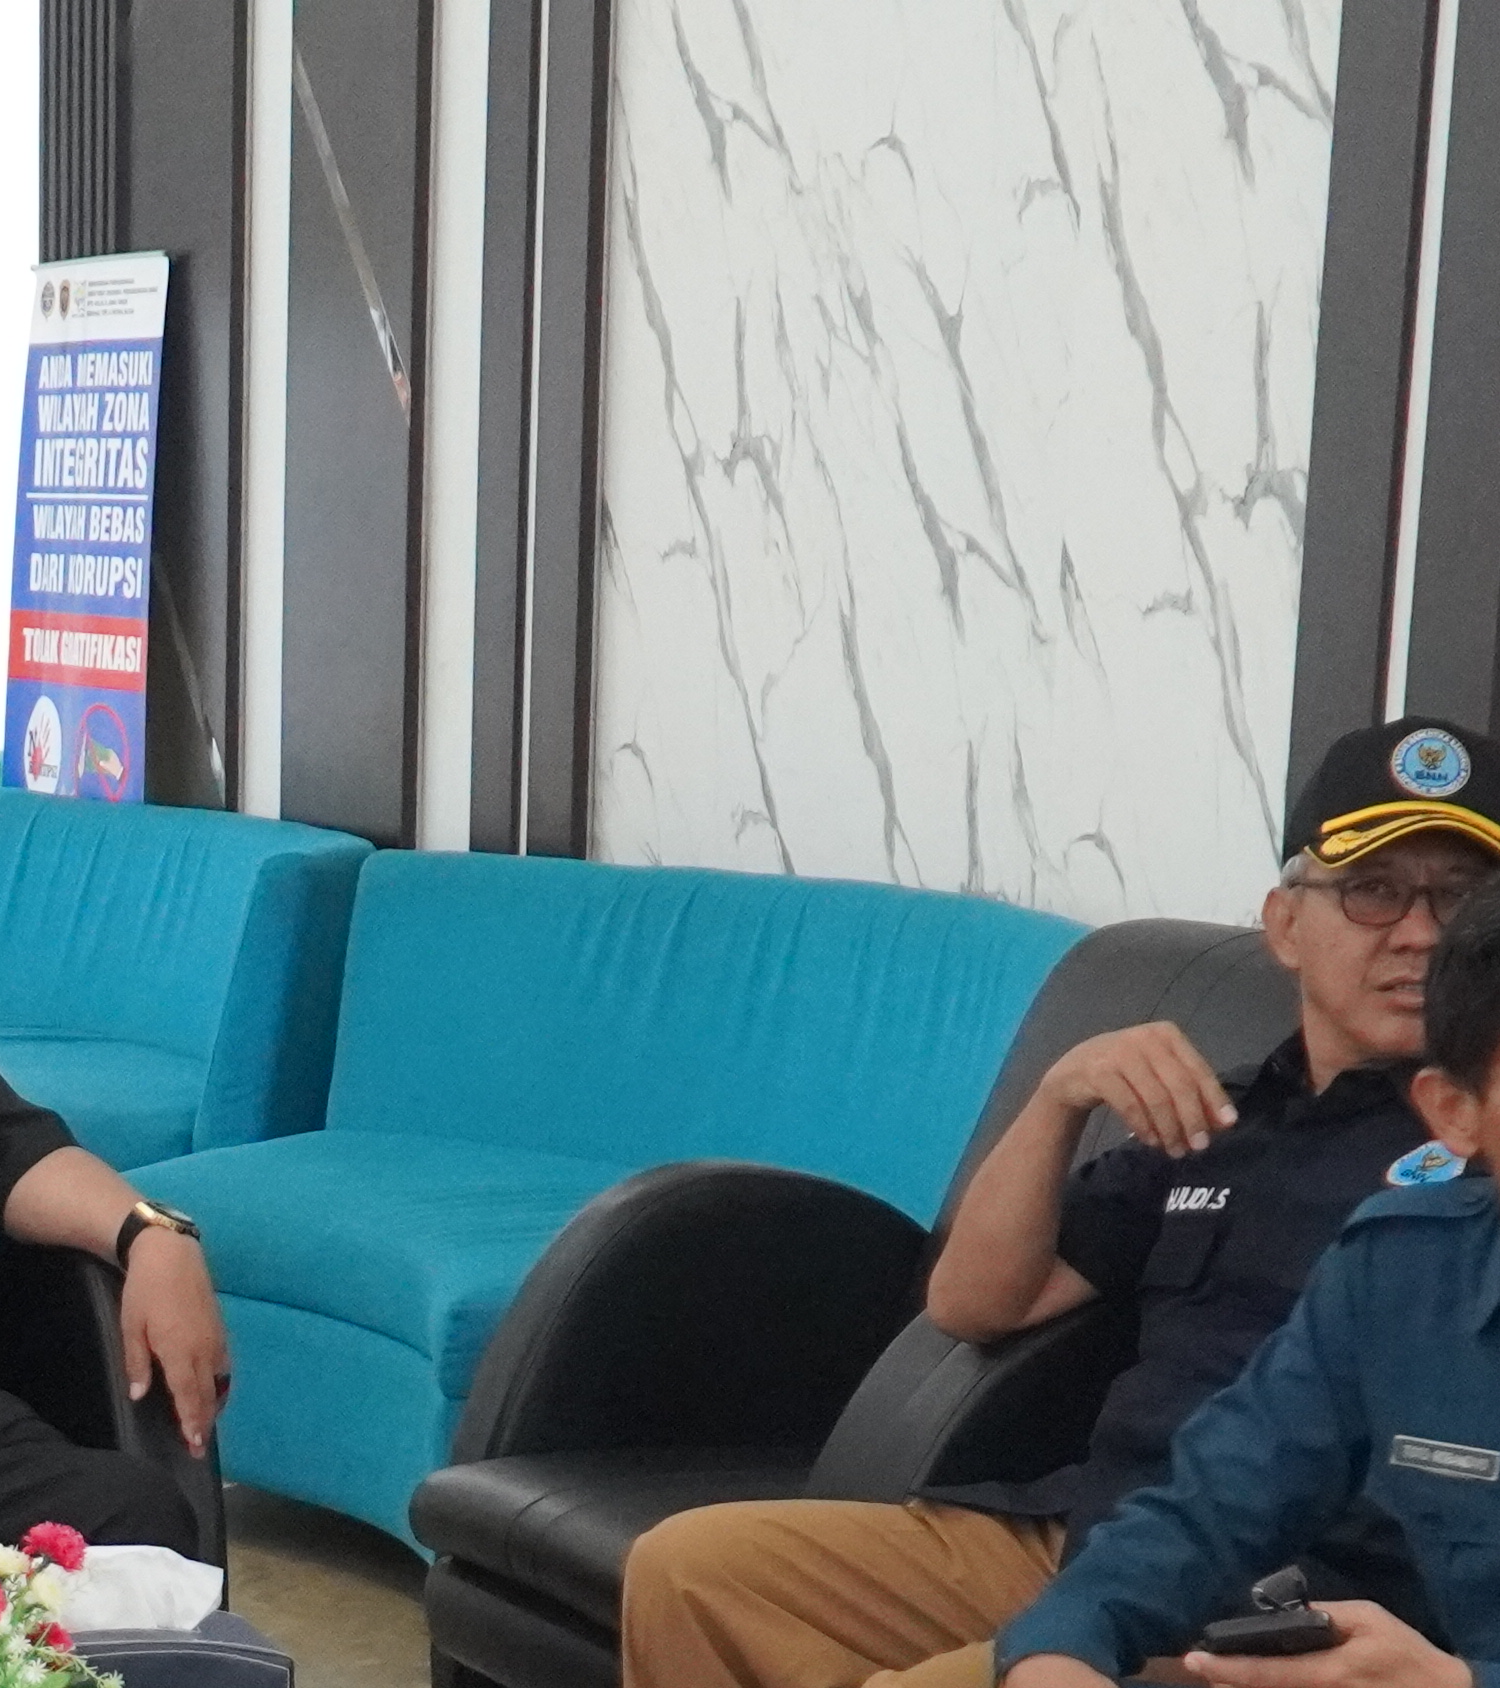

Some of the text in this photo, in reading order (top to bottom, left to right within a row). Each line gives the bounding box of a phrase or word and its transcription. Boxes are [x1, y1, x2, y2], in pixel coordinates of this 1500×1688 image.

[39, 350, 153, 389] ANDA MEMASUKI
[38, 392, 150, 432] WILAYAH ZONA
[34, 437, 148, 488] INTEGRITAS
[34, 504, 145, 544] WILAYAH BEBAS
[30, 552, 142, 599] DARI KORUPSI
[23, 627, 58, 663] TOLAK
